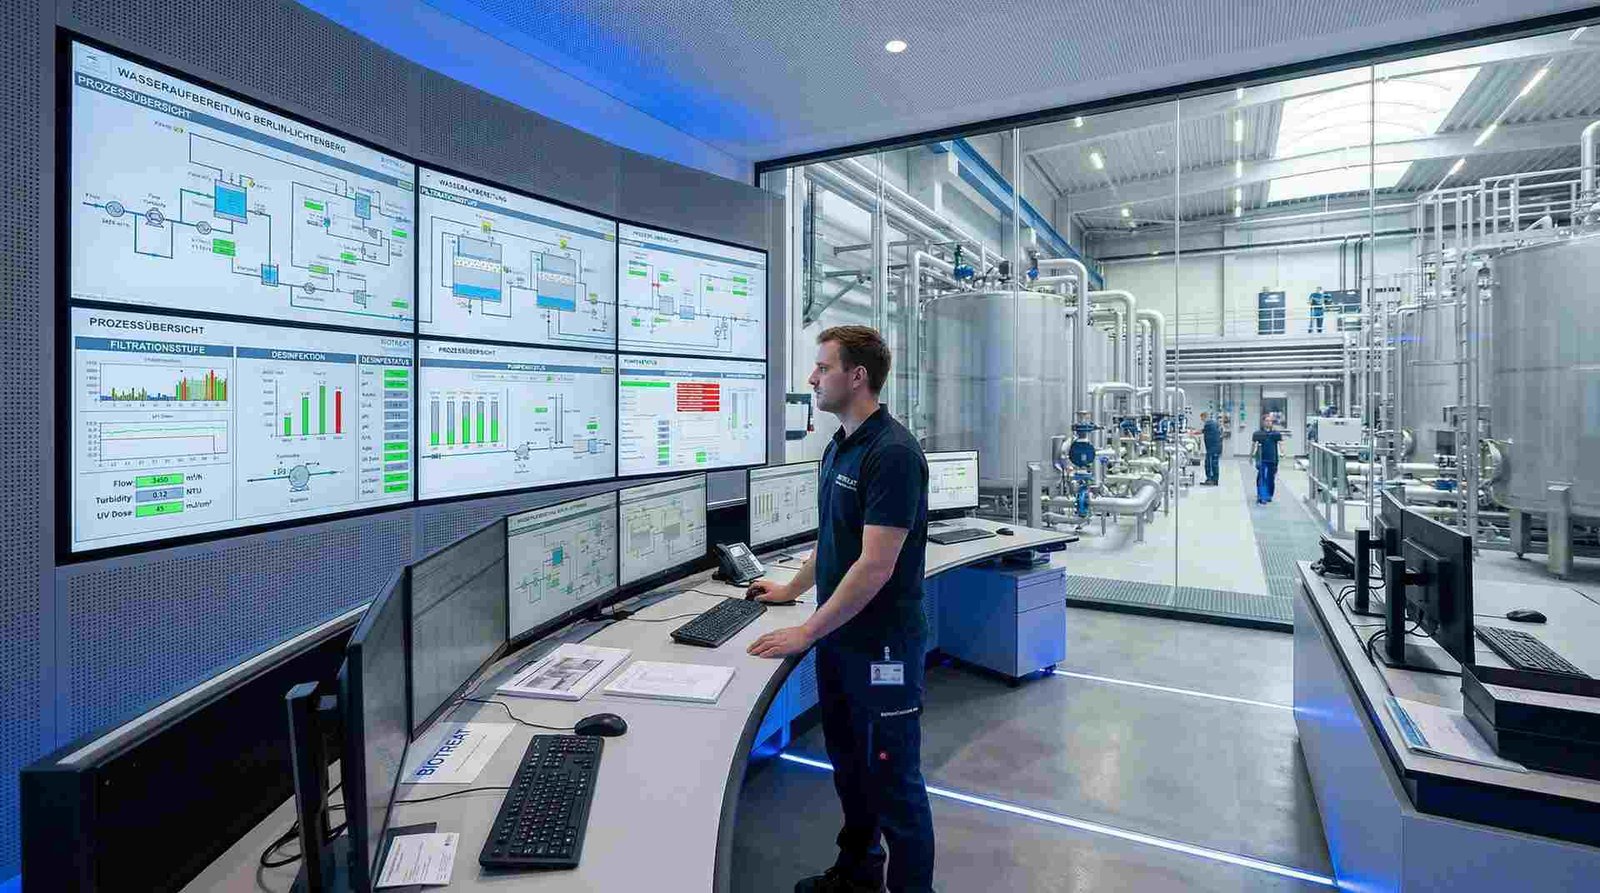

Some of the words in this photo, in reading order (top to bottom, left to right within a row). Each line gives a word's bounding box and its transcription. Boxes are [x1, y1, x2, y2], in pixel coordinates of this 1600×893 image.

[78, 76, 193, 120] PROZESSÜBERSICHT
[117, 66, 252, 121] WASSERAUFBEREITUNG
[253, 115, 347, 154] BERLIN-LICHTENBERG
[89, 317, 205, 335] PROZESSÜBERSICHT
[110, 340, 206, 354] FILTRATIONSSTUFE
[271, 351, 326, 361] DESINFEKTION
[113, 480, 134, 488] Flow
[96, 494, 132, 504] Turbidity
[186, 487, 202, 495] NTU
[97, 511, 110, 520] UV
[111, 510, 133, 518] Dose
[416, 729, 472, 776] BIOTREAT
